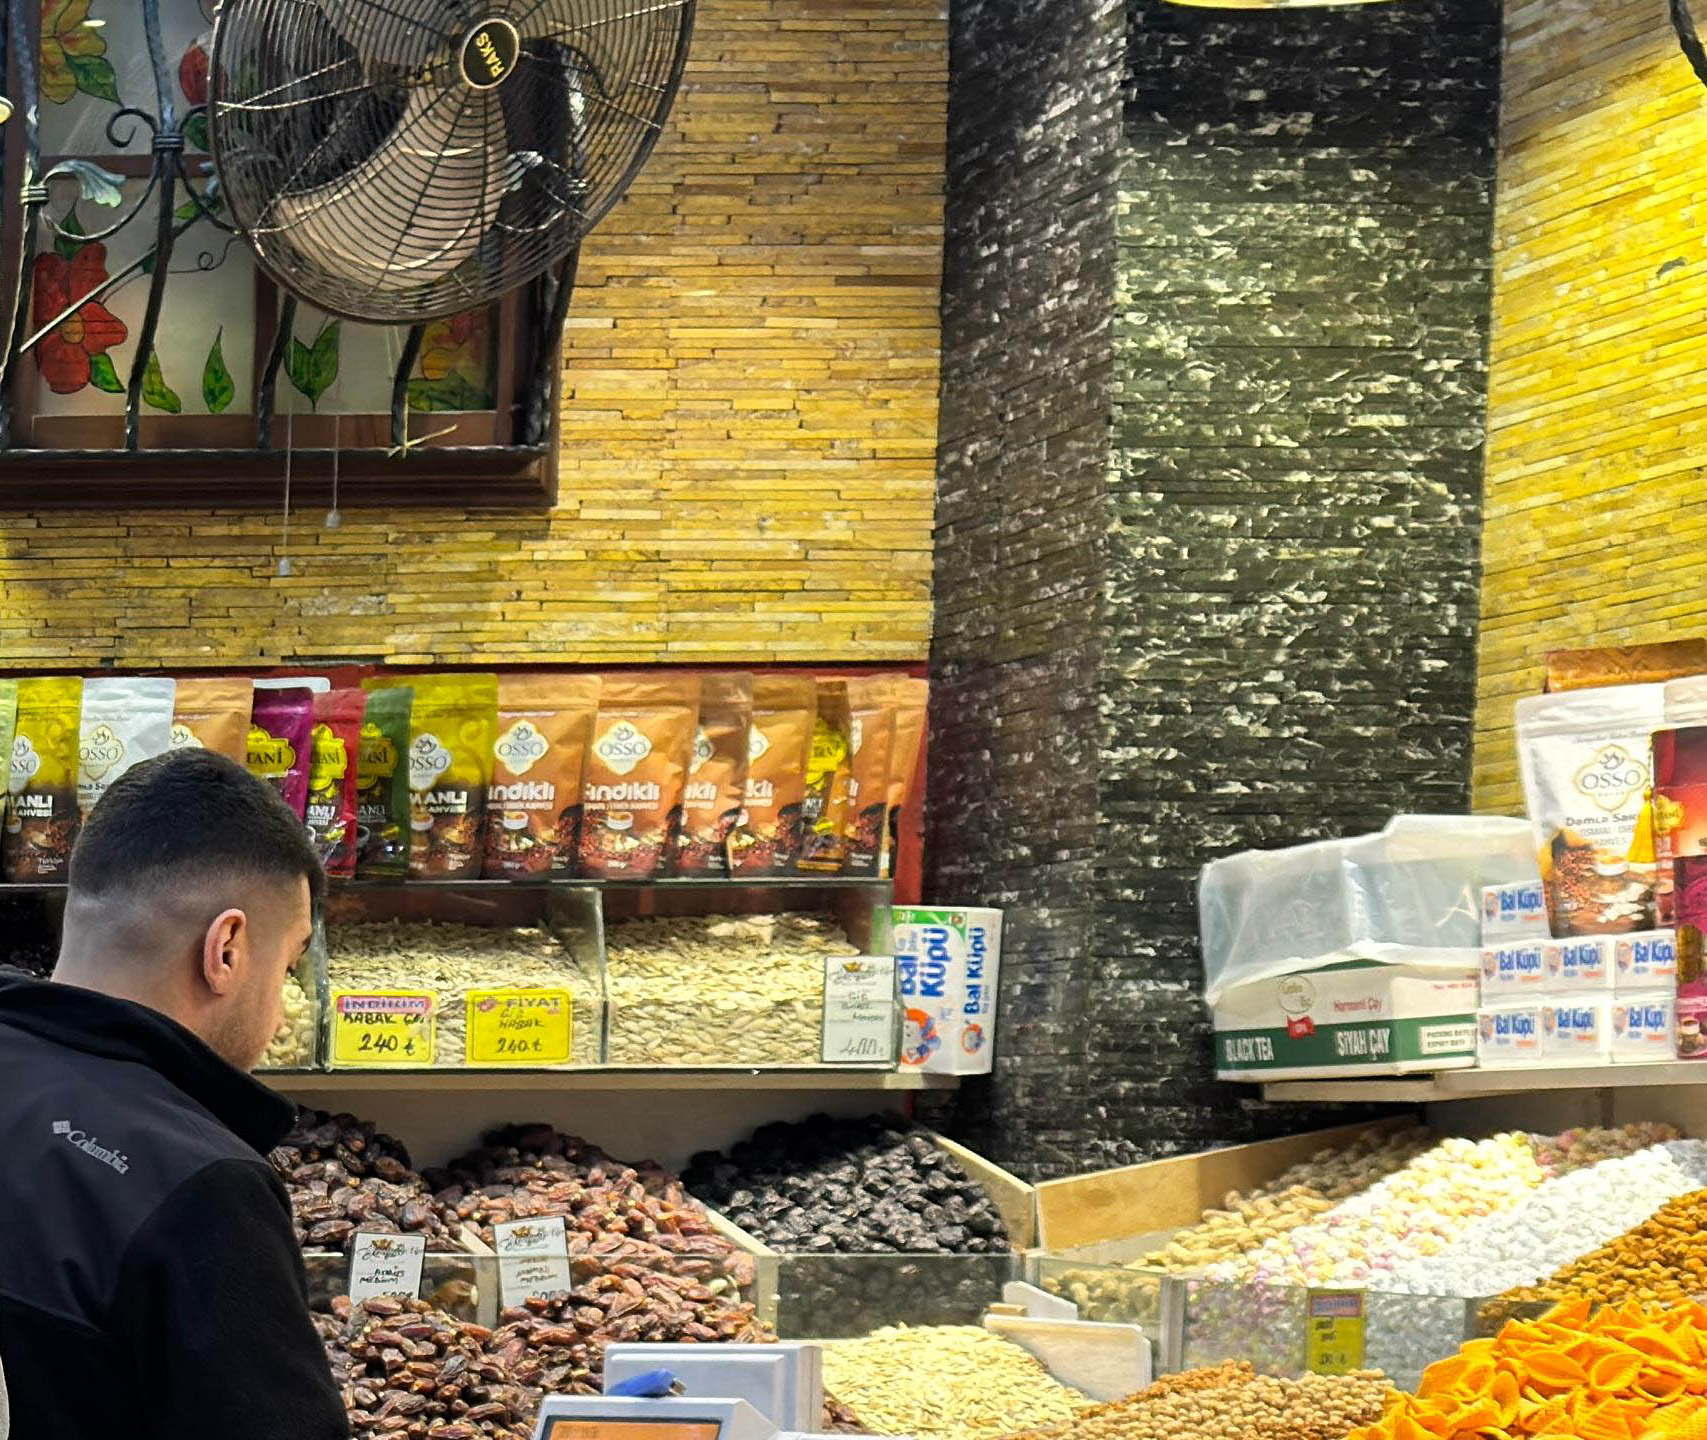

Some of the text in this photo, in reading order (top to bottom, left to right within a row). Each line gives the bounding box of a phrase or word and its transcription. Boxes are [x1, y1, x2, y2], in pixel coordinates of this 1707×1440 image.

[476, 31, 505, 77] RAKS
[498, 741, 544, 758] OSSO
[600, 741, 647, 758] OSSO
[1581, 769, 1641, 791] OSSO
[505, 995, 562, 1011] FİYAT
[963, 984, 982, 1014] Bal
[1257, 1036, 1275, 1062] TEA
[1369, 1027, 1391, 1061] ÇAY
[67, 1130, 130, 1175] Columbia
